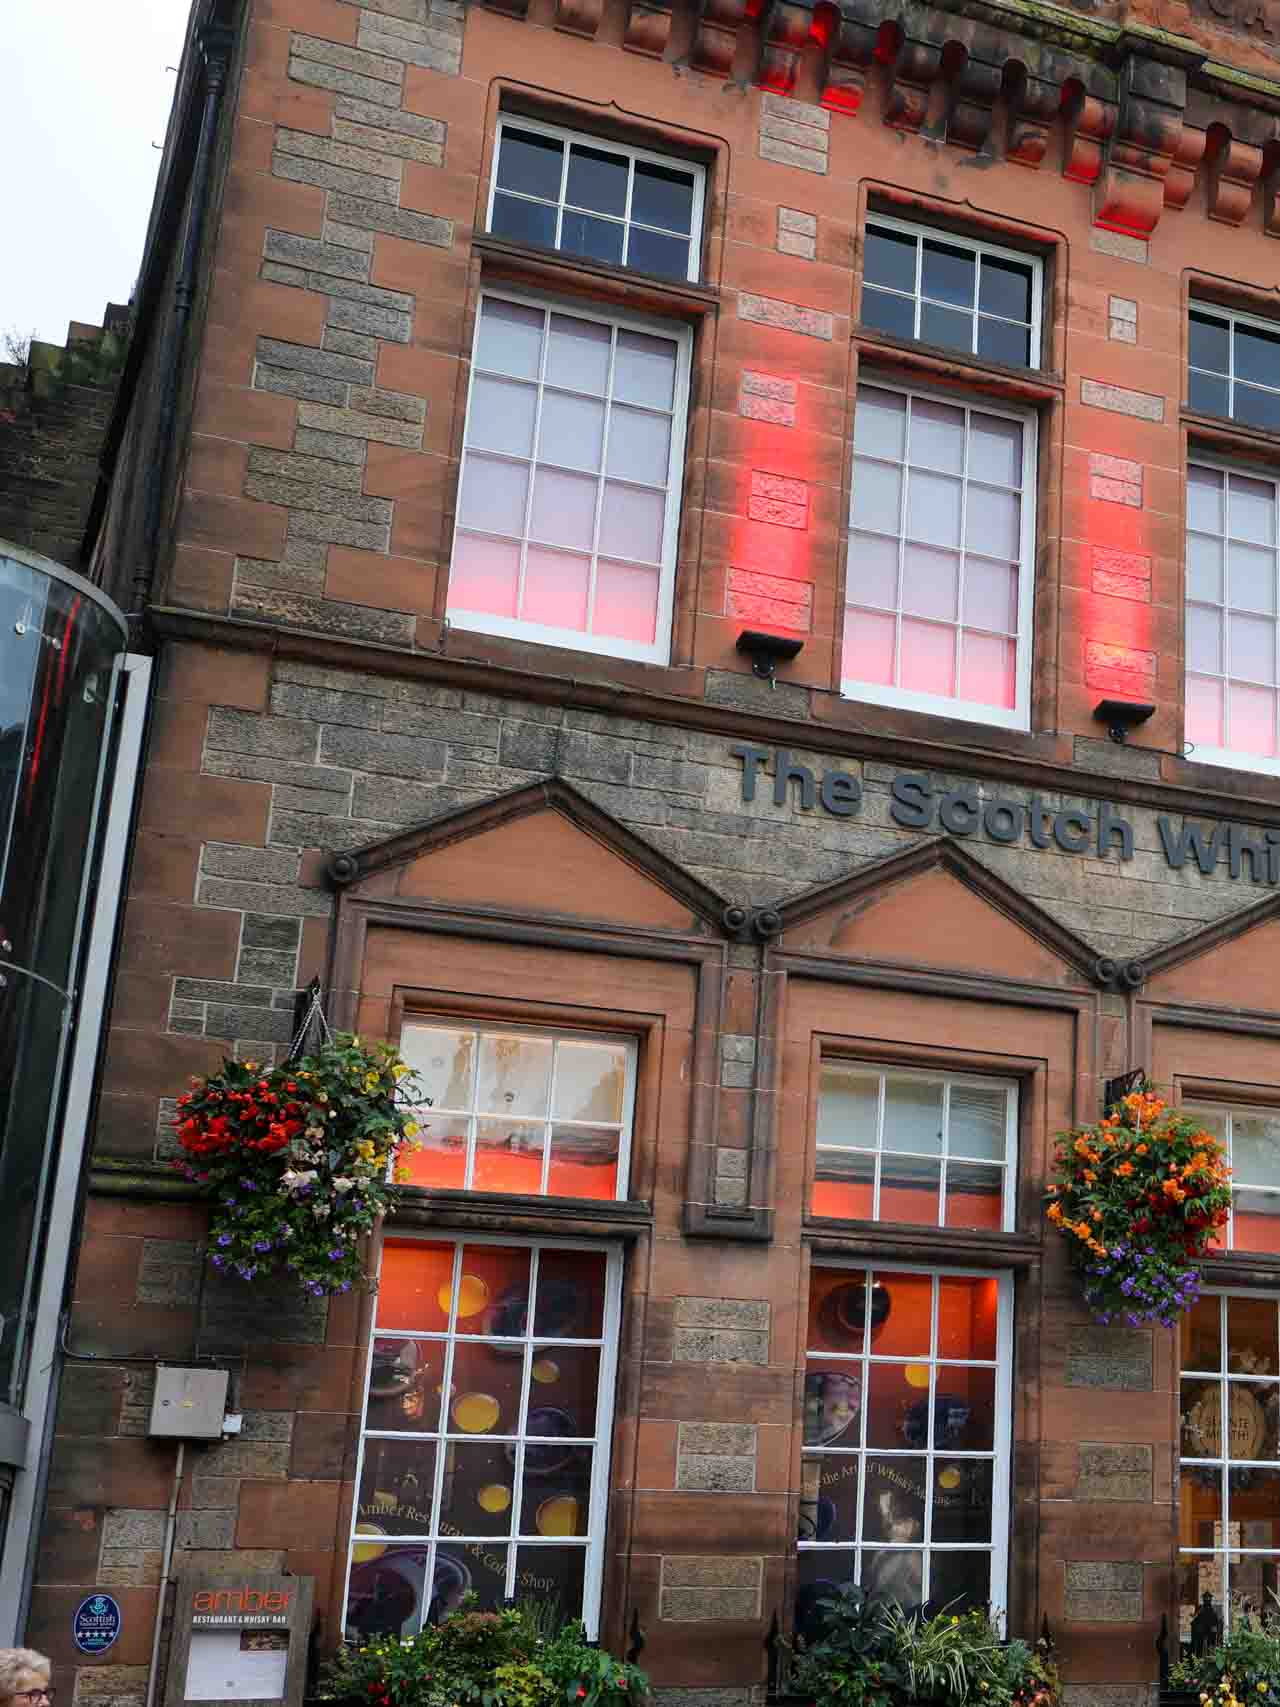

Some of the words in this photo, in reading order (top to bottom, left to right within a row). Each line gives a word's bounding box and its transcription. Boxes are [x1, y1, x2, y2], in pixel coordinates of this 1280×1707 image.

[731, 744, 862, 817] The
[889, 772, 1134, 861] Scotch
[192, 1584, 292, 1613] amber
[80, 1614, 115, 1625] Scottish
[192, 1615, 237, 1625] RESTAURANT
[243, 1615, 270, 1625] WHISKY
[272, 1615, 286, 1625] BAR
